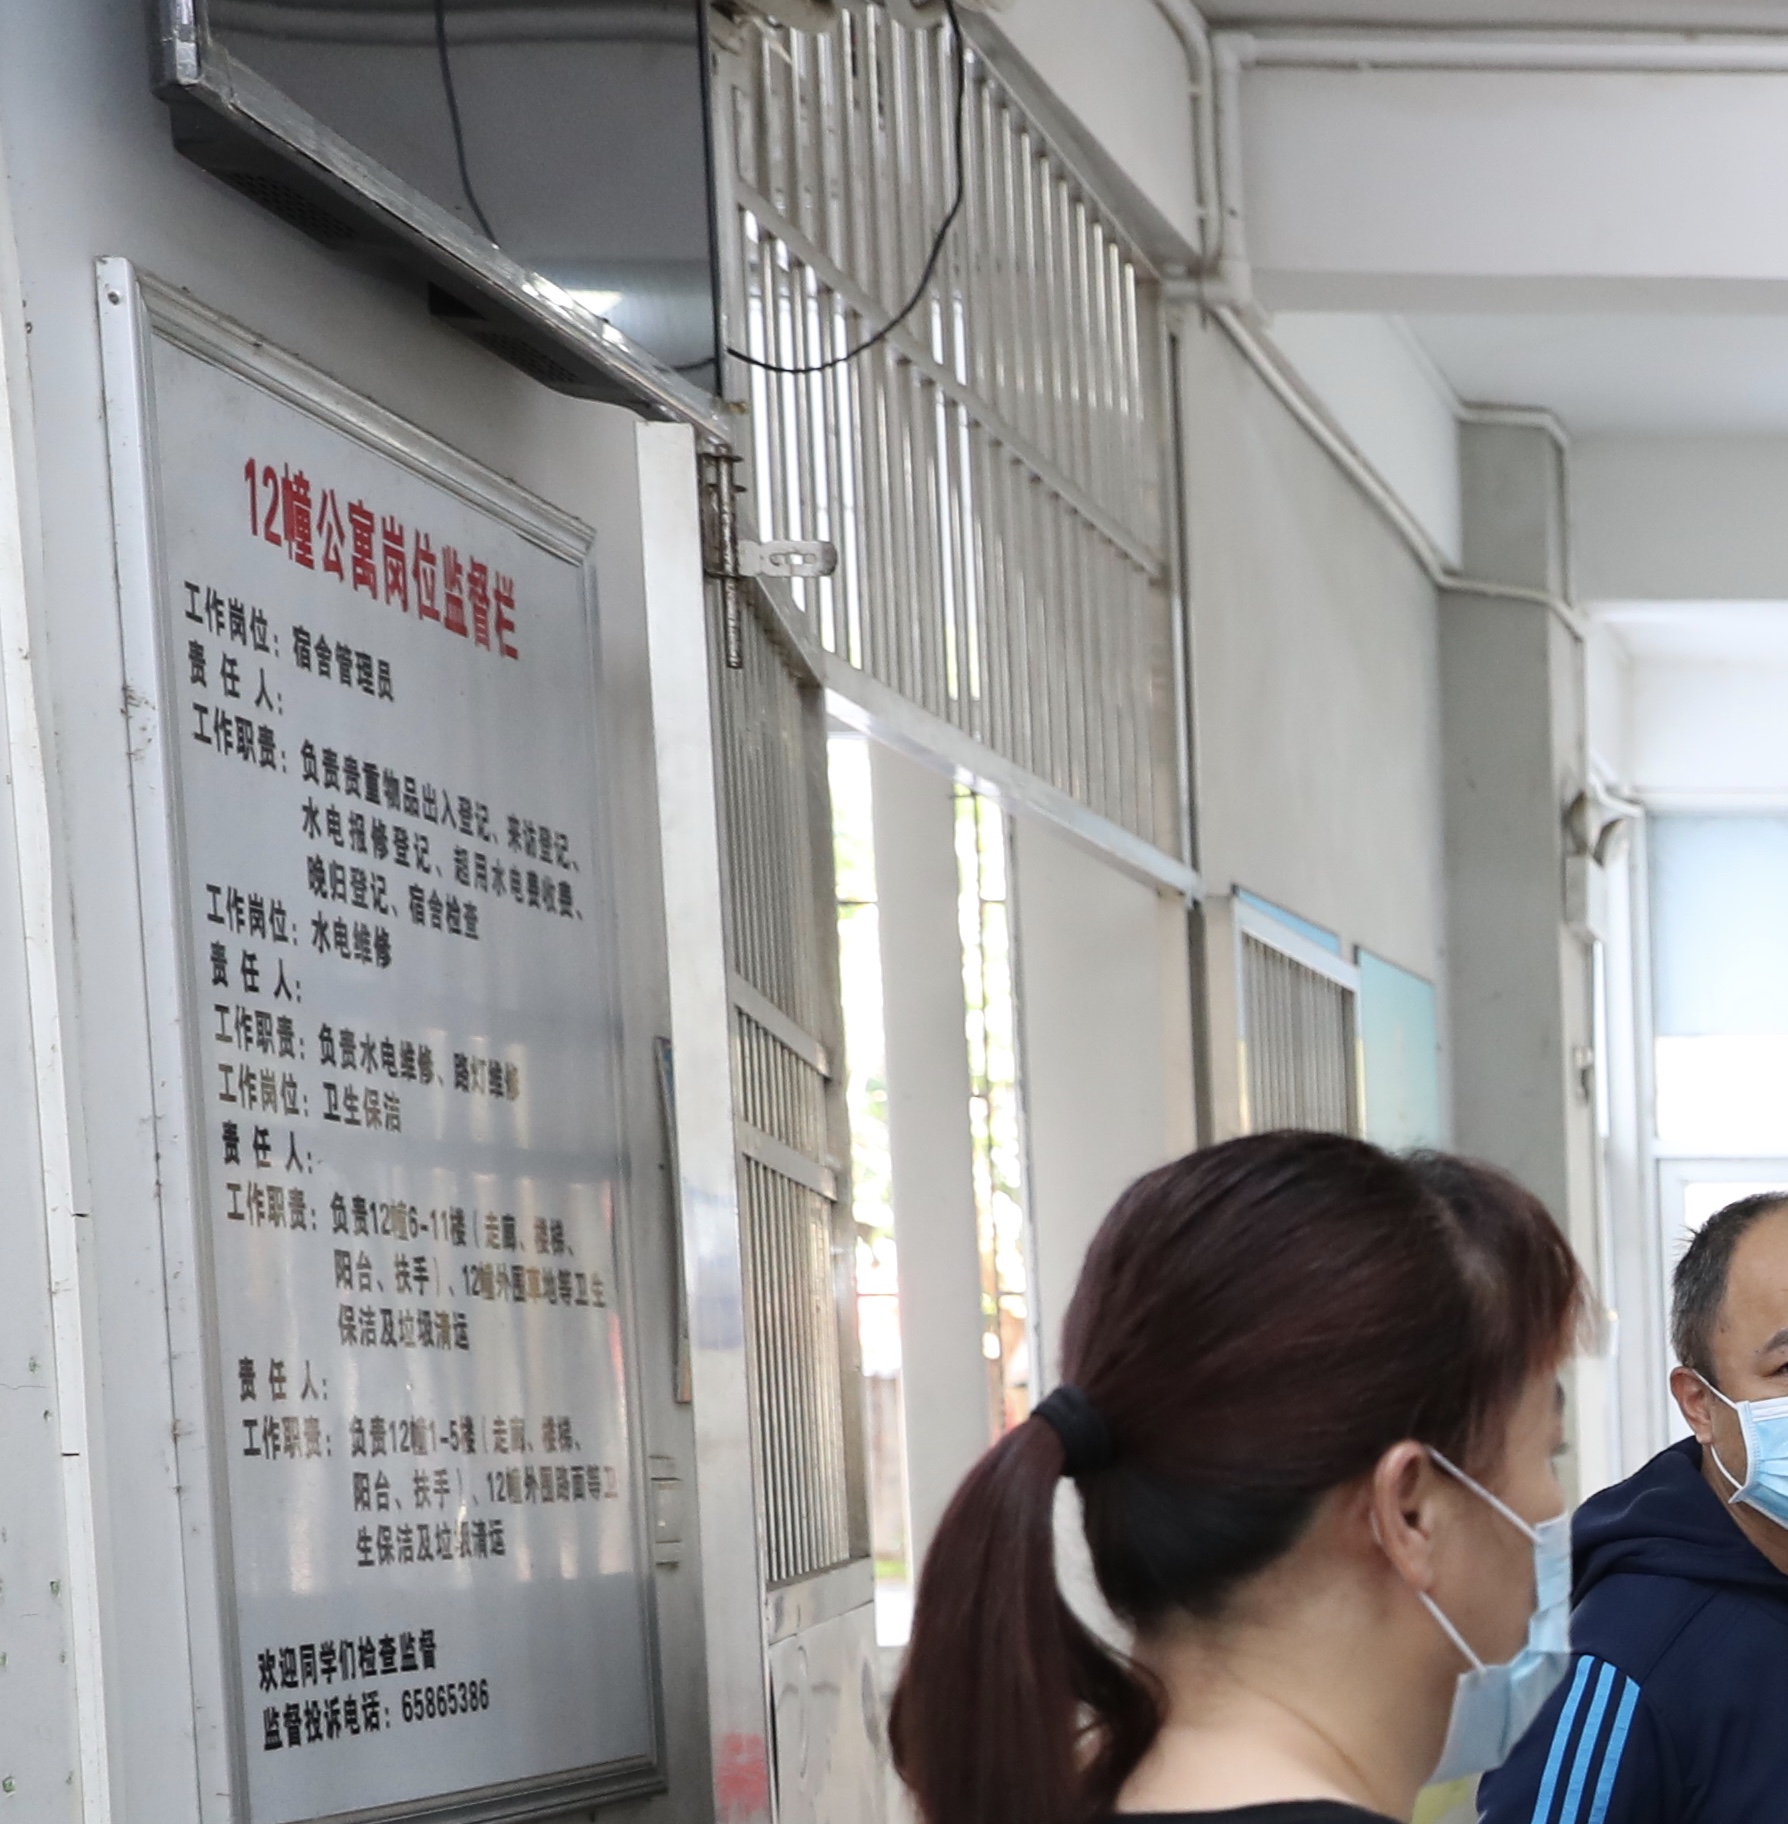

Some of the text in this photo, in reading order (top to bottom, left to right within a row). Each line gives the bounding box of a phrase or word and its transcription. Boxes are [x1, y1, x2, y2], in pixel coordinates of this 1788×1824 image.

[245, 457, 519, 661] 12幢公寓岗位监督栏
[257, 1628, 436, 1693] 欢迎同学们检查监督
